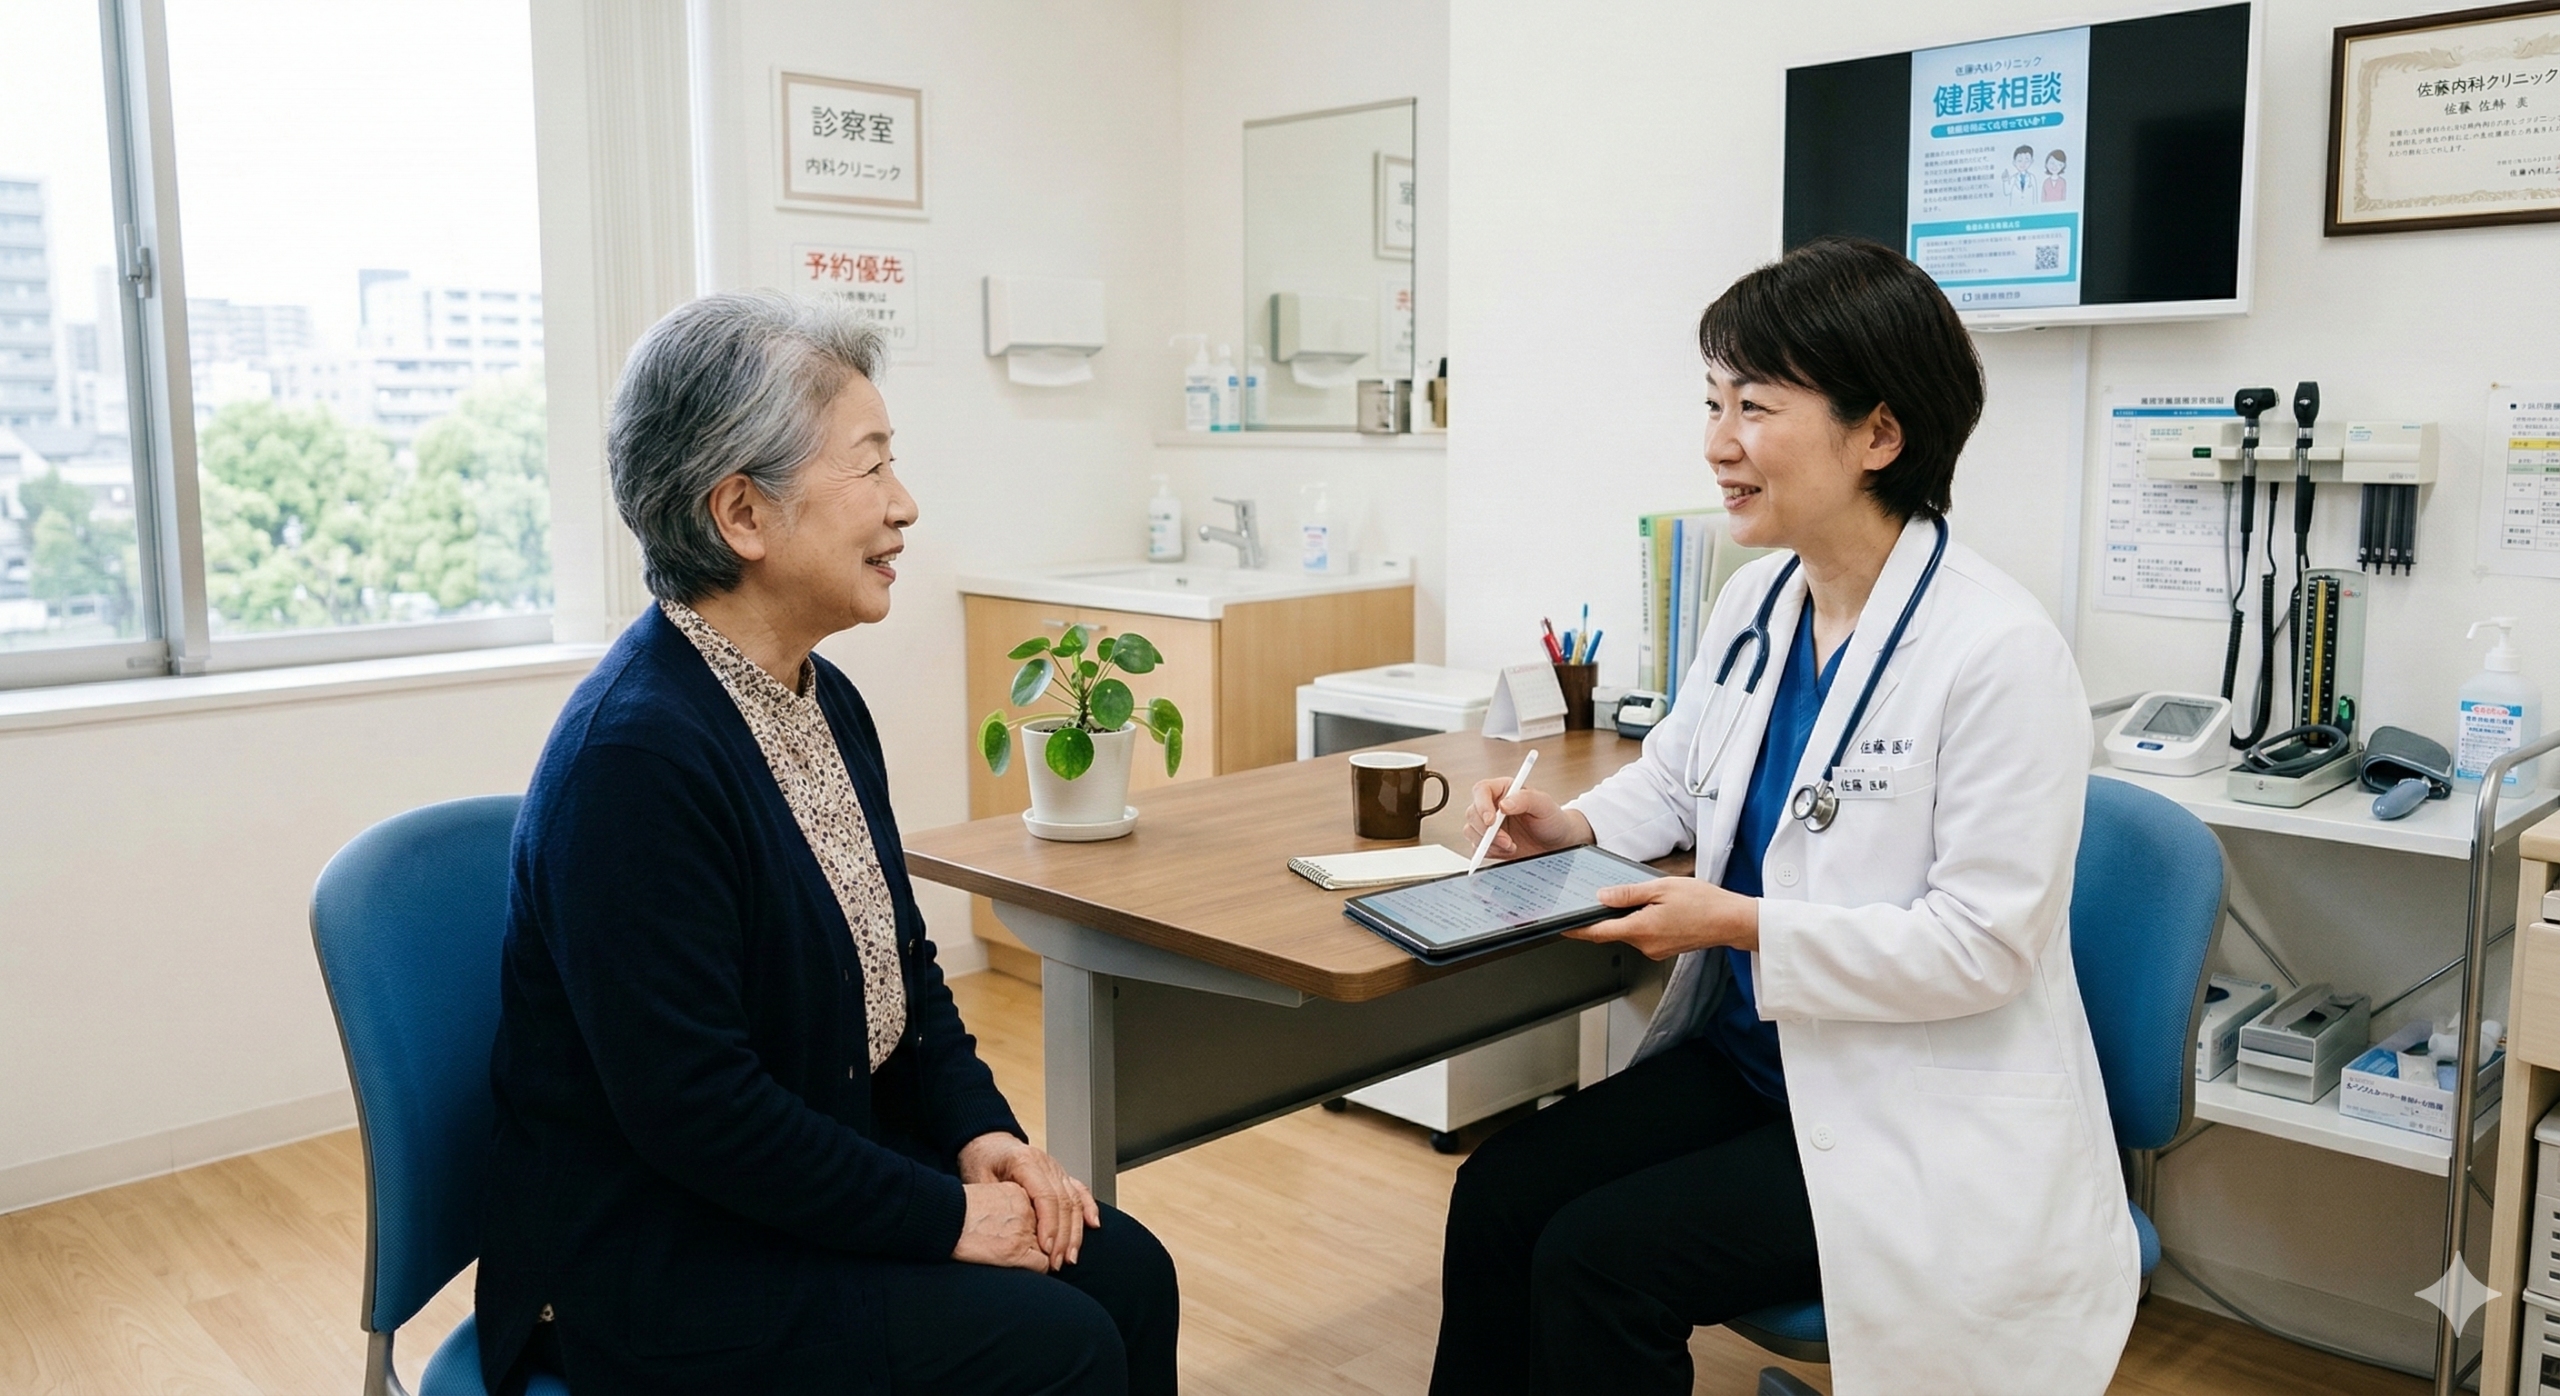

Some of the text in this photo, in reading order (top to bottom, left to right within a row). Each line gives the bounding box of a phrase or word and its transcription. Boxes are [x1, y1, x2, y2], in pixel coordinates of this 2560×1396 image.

[1933, 71, 2062, 118] 健康相談
[2417, 68, 2559, 98] 佐藤内科クリニック
[812, 106, 894, 144] 診察室
[806, 157, 901, 181] 内科クリニック
[804, 252, 904, 284] 予約優先
